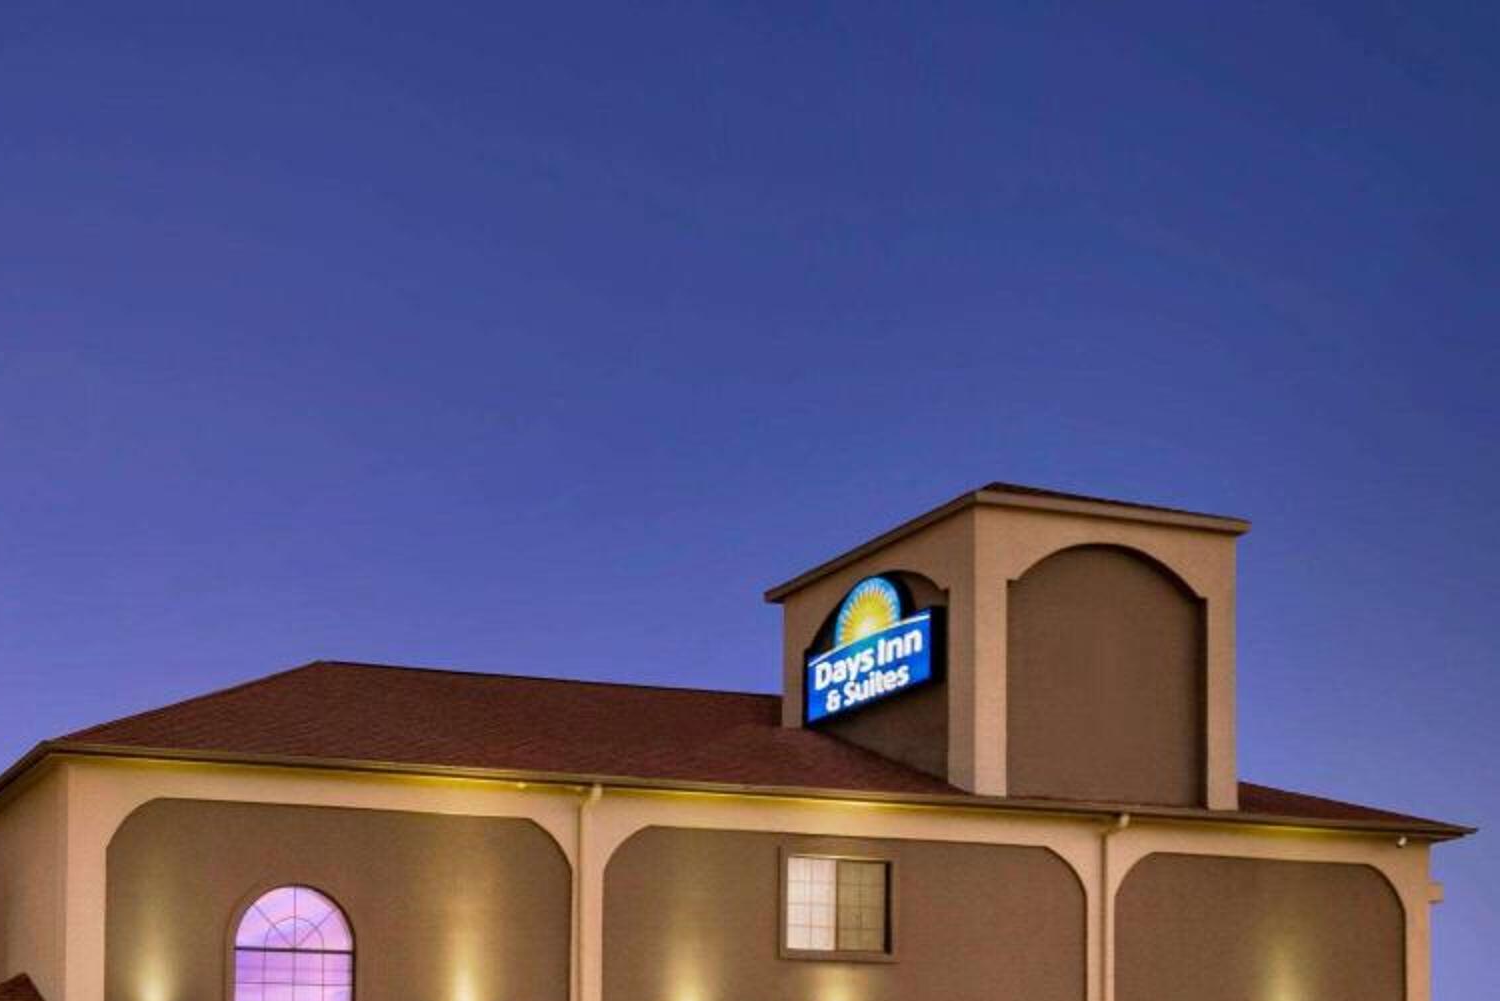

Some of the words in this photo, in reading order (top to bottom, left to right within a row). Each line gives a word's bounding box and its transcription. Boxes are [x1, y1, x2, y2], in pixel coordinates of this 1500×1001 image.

[814, 647, 875, 691] Days
[876, 629, 923, 666] Inn
[825, 688, 842, 713] &
[843, 664, 910, 706] Suites
